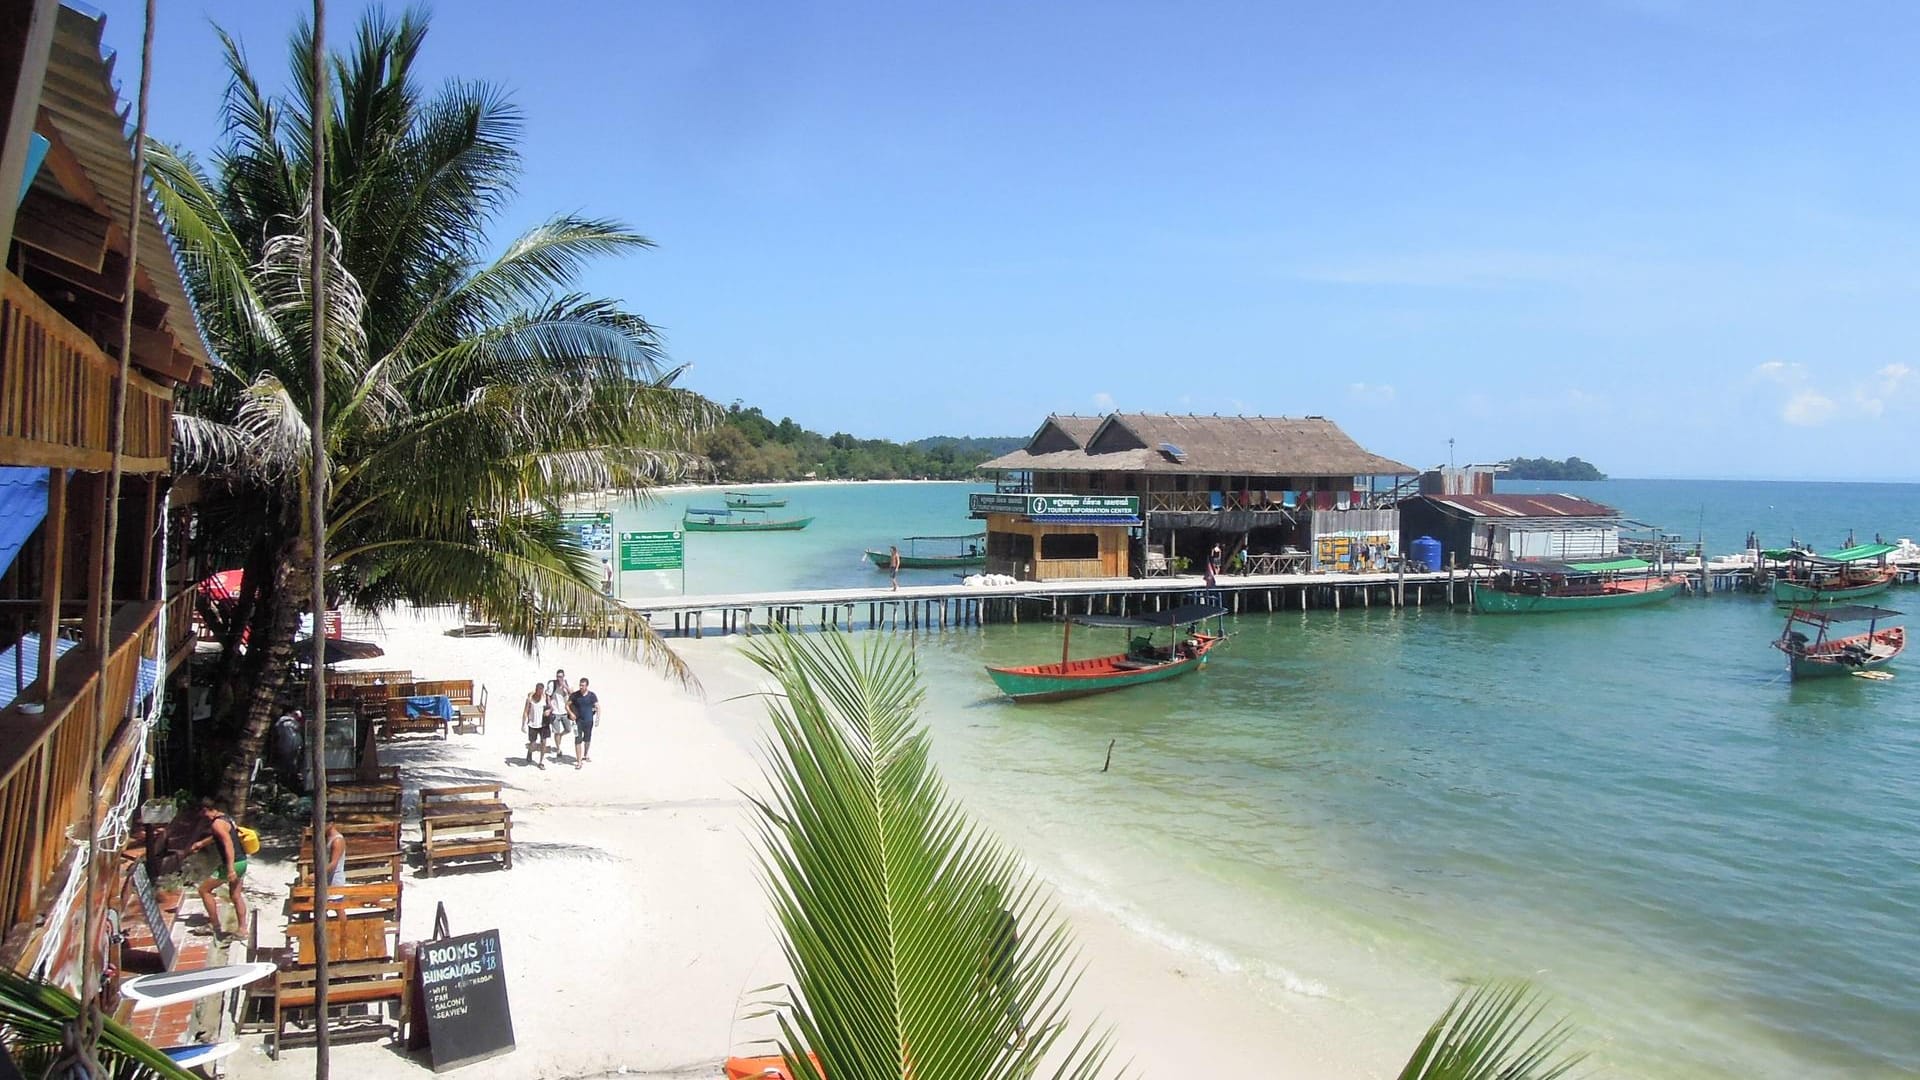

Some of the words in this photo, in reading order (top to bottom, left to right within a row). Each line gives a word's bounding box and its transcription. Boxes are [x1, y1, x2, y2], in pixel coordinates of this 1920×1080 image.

[428, 941, 478, 966] ROOMS
[422, 960, 481, 985] BUNGALOWS
[435, 997, 465, 1011] BALCONY
[436, 1006, 468, 1020] SEAVIEW
